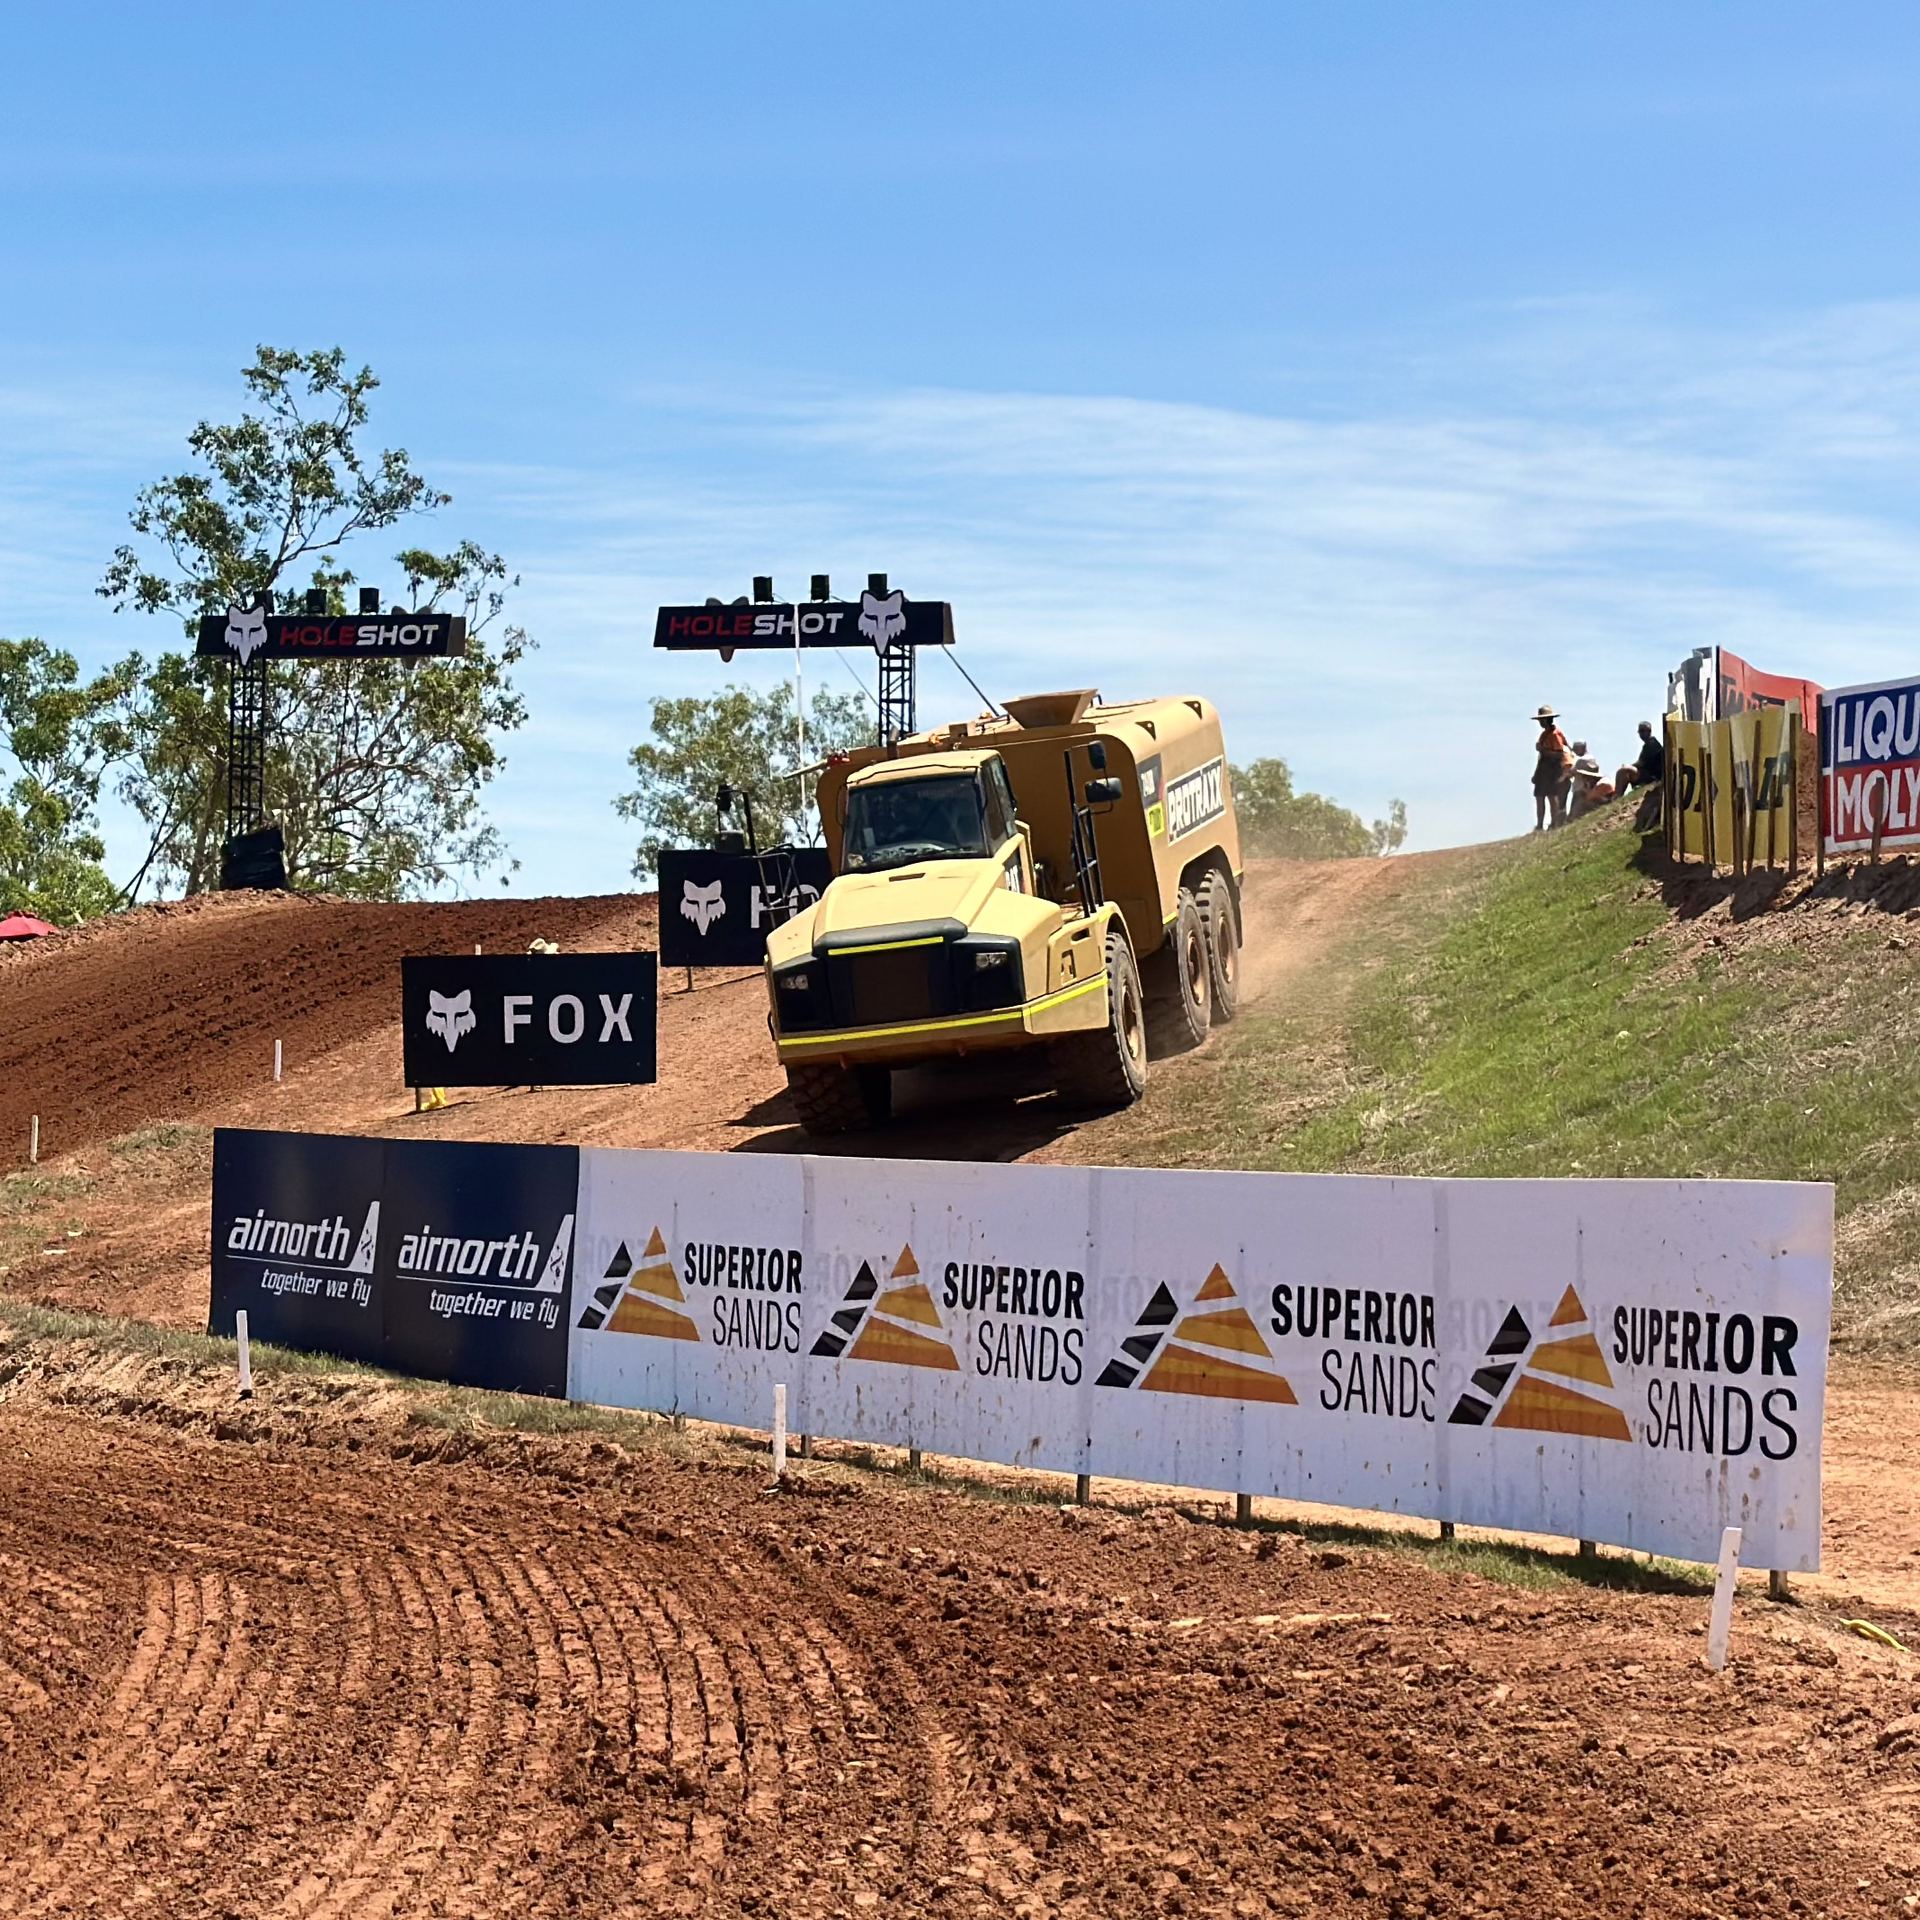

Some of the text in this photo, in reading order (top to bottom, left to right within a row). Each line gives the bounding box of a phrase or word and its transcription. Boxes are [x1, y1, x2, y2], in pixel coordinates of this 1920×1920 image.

[279, 623, 439, 647] HOLESHOT
[668, 612, 844, 637] HOLESHOT
[1837, 691, 1920, 762] LIQU
[1167, 765, 1223, 835] PROTRAXX
[1837, 767, 1920, 835] MOLY
[751, 884, 820, 929] FO
[503, 993, 634, 1044] FOX
[228, 1209, 351, 1261] airnorth
[398, 1225, 540, 1280] airnorth
[261, 1268, 372, 1306] together we fly
[684, 1242, 801, 1294] SUPERIOR
[942, 1262, 1085, 1319] SUPERIOR
[429, 1289, 560, 1329] together we fly
[712, 1295, 800, 1353] SANDS
[1270, 1284, 1435, 1348] SUPERIOR
[976, 1320, 1083, 1386] SANDS
[1613, 1305, 1799, 1377] SUPERIOR
[1320, 1348, 1435, 1422] SANDS
[1646, 1378, 1799, 1461] SANDS
